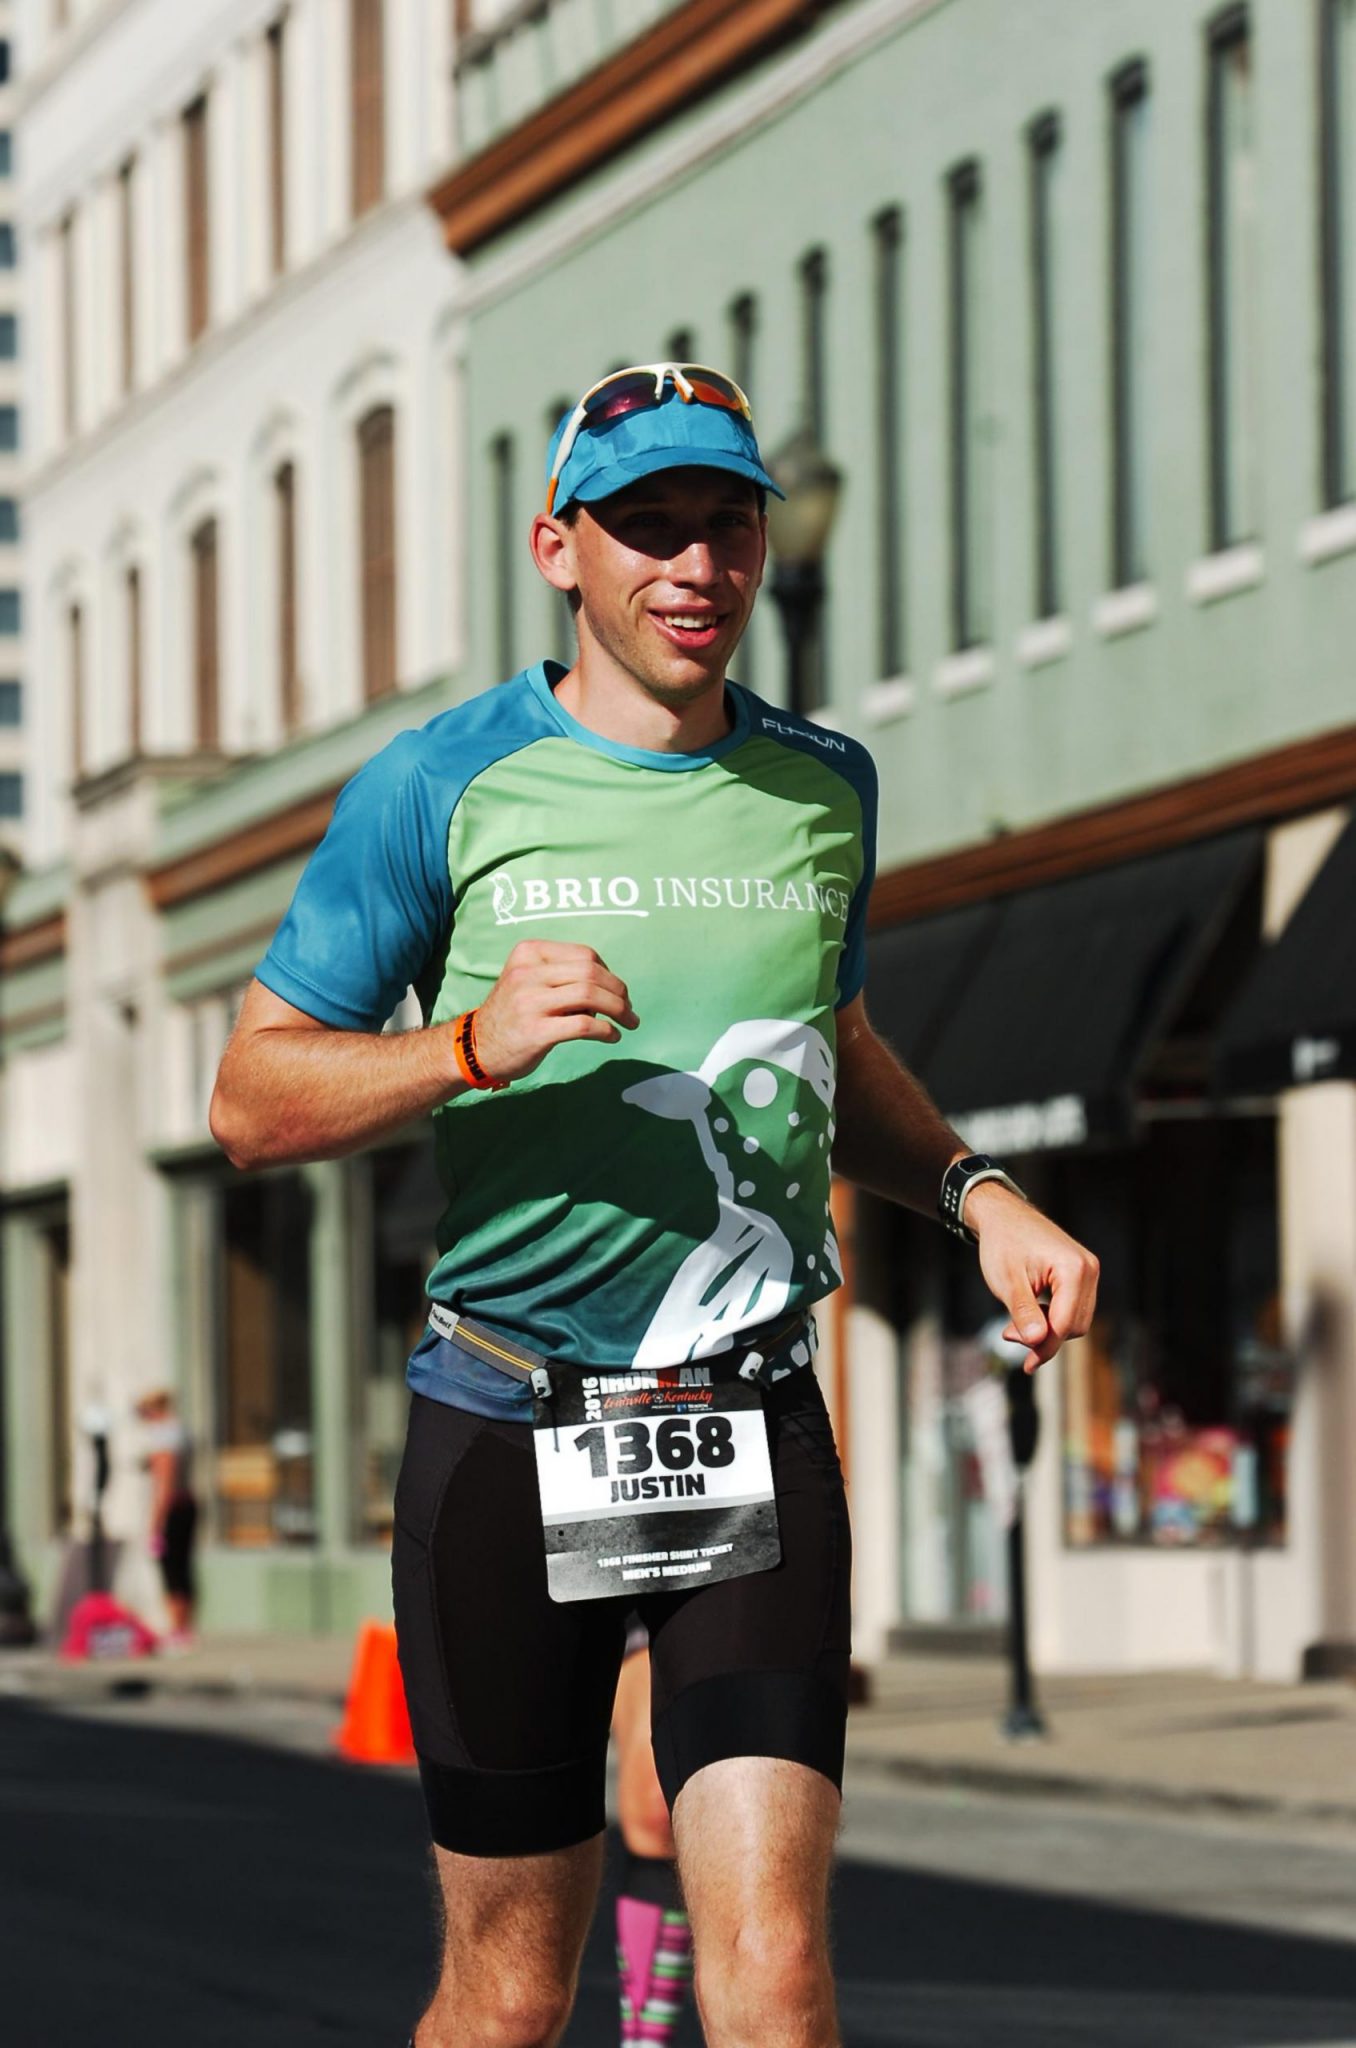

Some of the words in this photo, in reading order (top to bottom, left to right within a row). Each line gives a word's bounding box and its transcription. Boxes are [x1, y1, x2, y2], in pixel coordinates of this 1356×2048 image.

[523, 876, 640, 911] BRIO
[653, 877, 849, 922] INSURANCE
[582, 1376, 603, 1422] 2016
[663, 1389, 714, 1405] Kentucky
[573, 1415, 736, 1479] 1368
[610, 1473, 707, 1504] JUSTIN
[622, 1551, 668, 1565] FINISHER
[669, 1548, 699, 1561] SHIRT
[622, 1566, 661, 1580] MEN'S
[661, 1561, 712, 1577] MEDIUM
